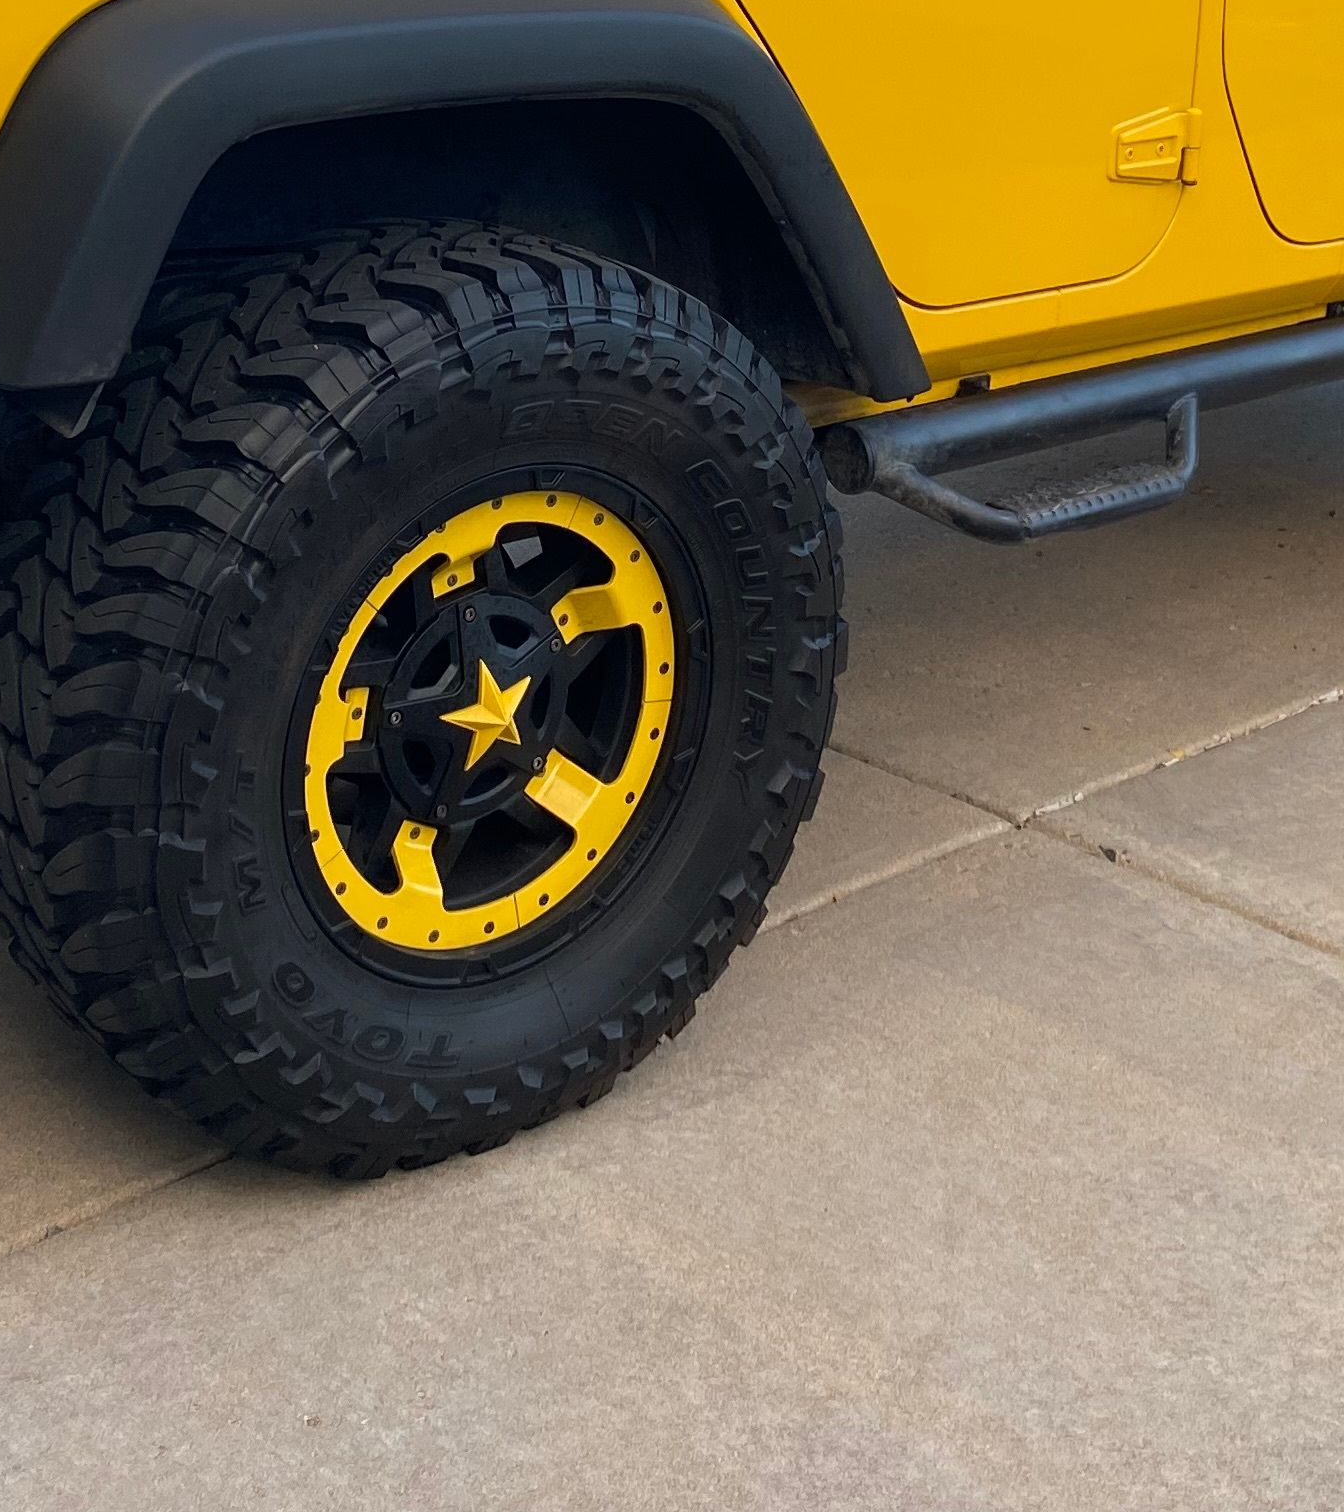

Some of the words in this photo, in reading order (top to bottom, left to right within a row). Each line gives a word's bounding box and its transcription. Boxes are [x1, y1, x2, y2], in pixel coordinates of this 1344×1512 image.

[502, 398, 685, 458] OPEN
[684, 458, 776, 793] COUNTRY
[271, 961, 461, 1069] TOYO
